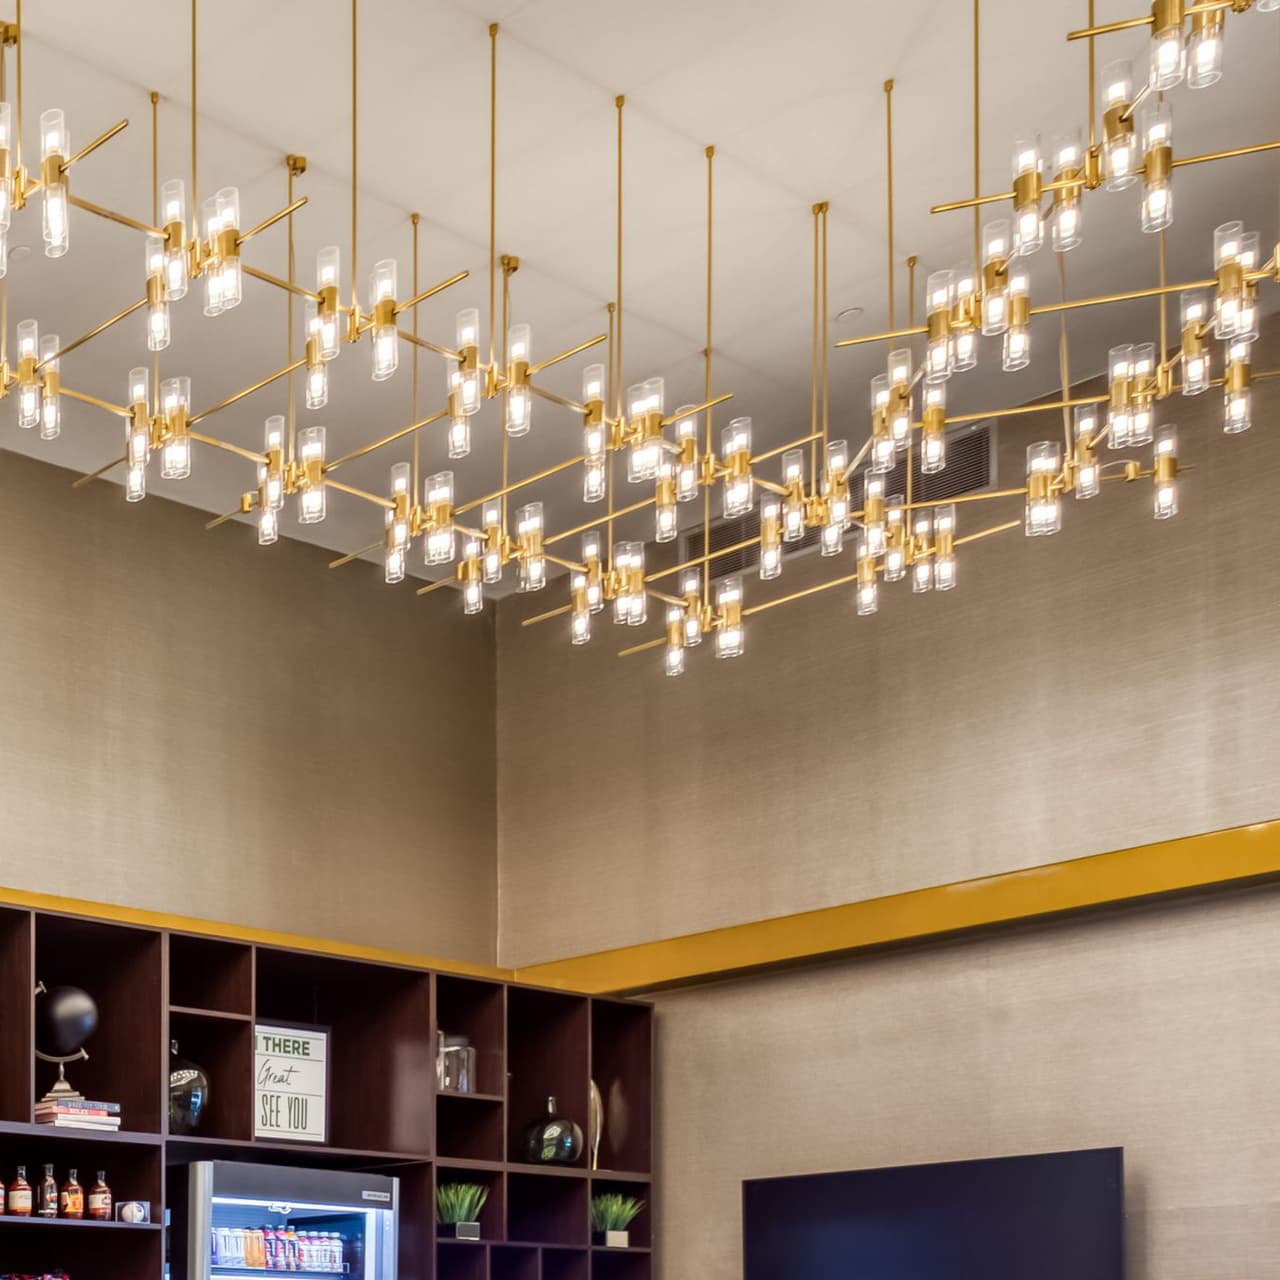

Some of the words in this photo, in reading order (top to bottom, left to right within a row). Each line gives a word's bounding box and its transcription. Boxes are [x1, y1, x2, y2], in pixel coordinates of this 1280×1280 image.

[262, 1036, 311, 1057] THERE
[257, 1058, 302, 1088] Great
[261, 1094, 281, 1128] SEE
[287, 1096, 308, 1130] YOU
